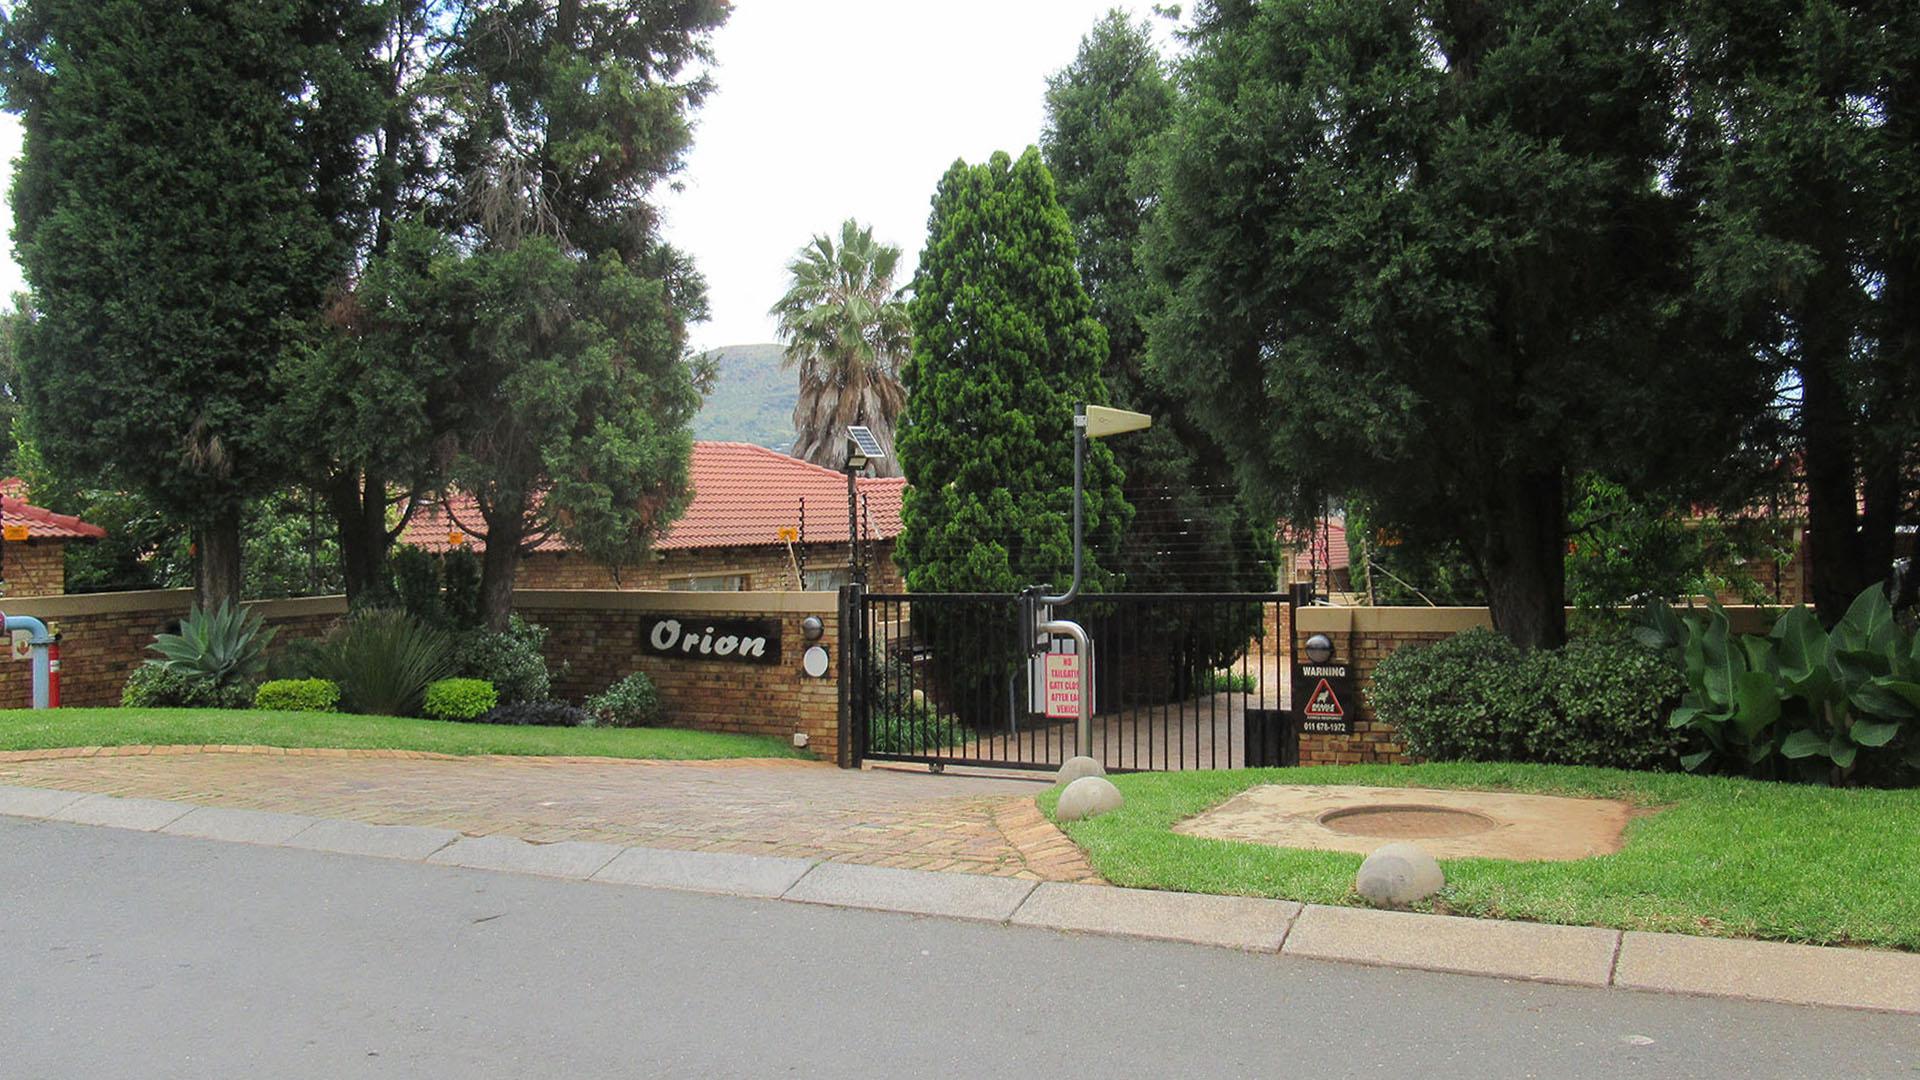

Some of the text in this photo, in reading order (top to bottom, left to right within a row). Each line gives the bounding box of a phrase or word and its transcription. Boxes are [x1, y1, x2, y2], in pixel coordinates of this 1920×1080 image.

[650, 619, 766, 657] Orion
[1063, 658, 1073, 666] NO
[1051, 669, 1079, 679] TAILGATI
[1302, 666, 1346, 677] WARNING
[1050, 681, 1064, 690] GATE
[1051, 693, 1069, 702] AFTER
[1056, 704, 1080, 714] VEHICL
[1303, 722, 1315, 731] 011
